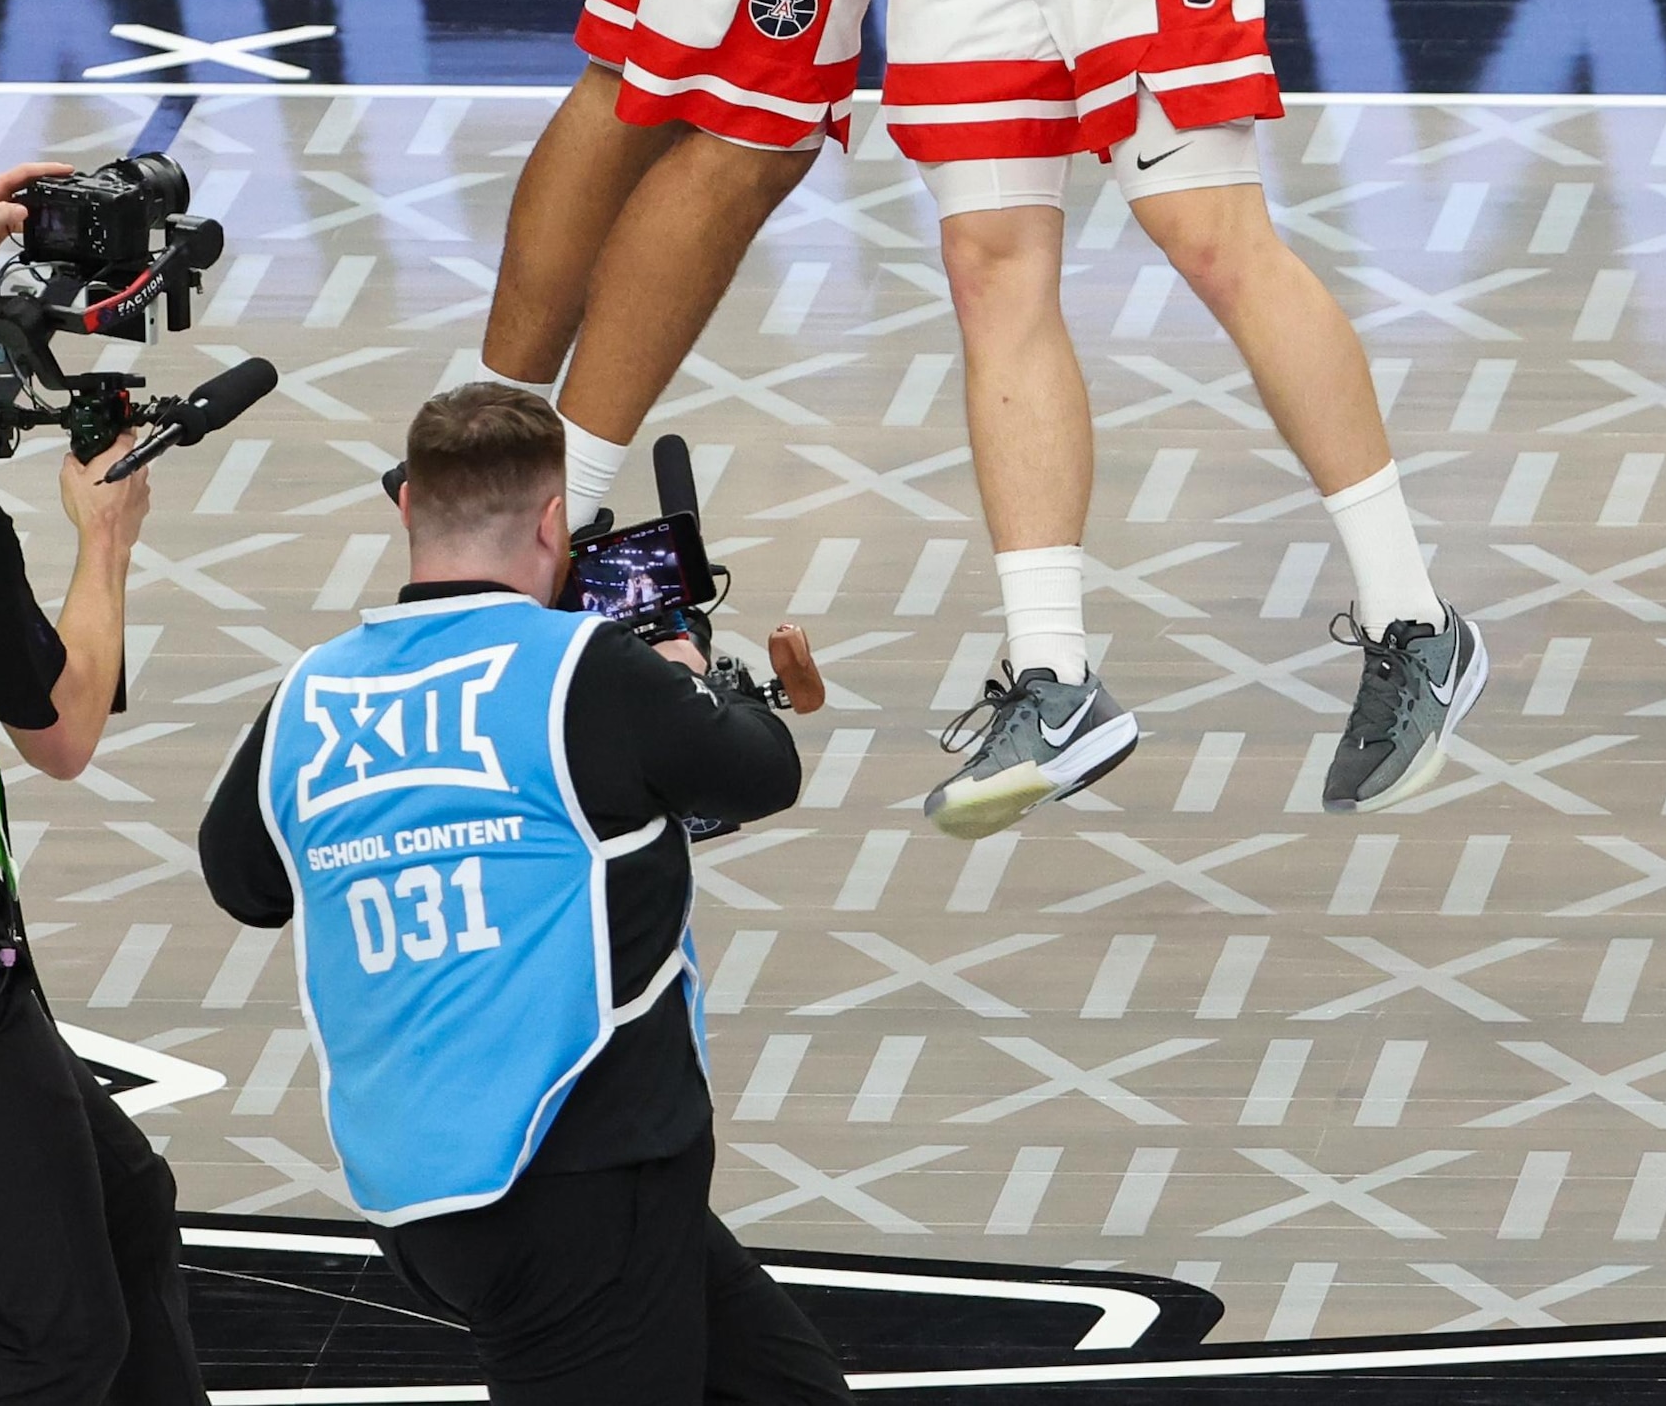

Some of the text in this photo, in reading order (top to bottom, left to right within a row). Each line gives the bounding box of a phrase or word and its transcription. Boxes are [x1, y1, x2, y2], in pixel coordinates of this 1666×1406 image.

[297, 644, 520, 822] XII
[307, 816, 523, 871] SCHOOL CONTENT
[346, 856, 502, 974] 031
